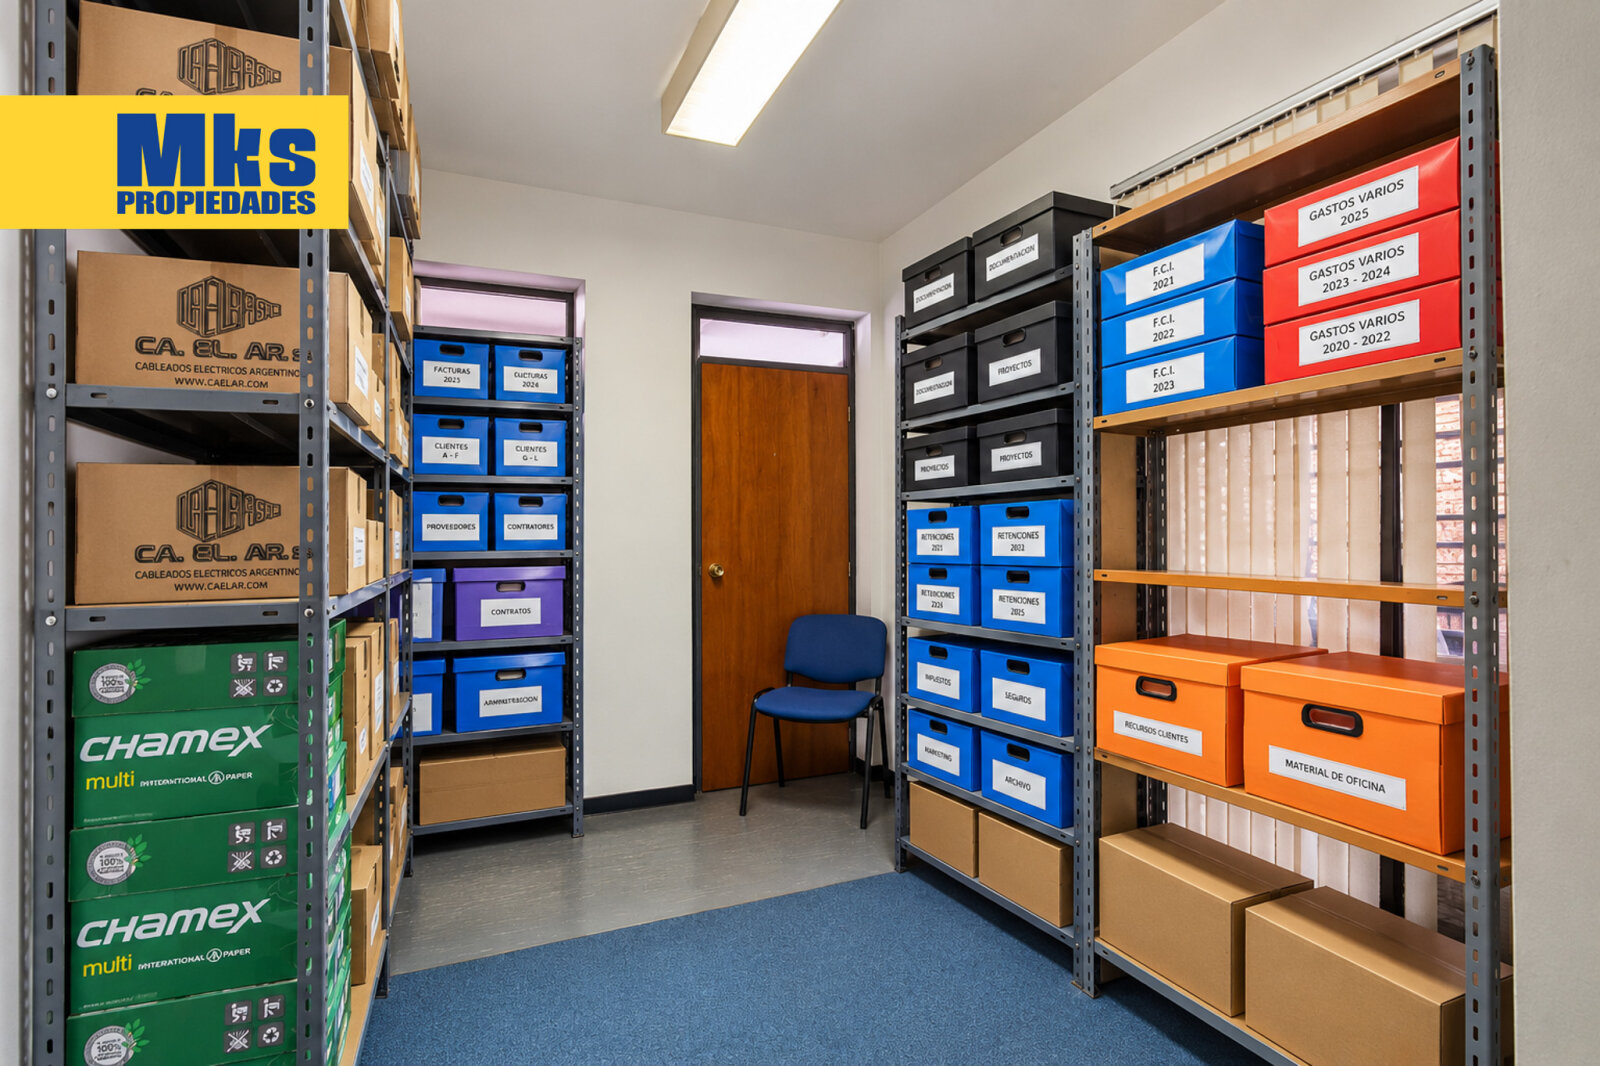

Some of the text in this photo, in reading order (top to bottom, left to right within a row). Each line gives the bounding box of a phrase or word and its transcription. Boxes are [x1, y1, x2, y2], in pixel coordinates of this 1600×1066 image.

[1309, 179, 1404, 221] GASTOS VARIOS
[1340, 207, 1369, 226] 2025
[1153, 263, 1174, 276] F.C.I.
[1309, 245, 1404, 281] GASTOS VARIOS
[1153, 276, 1174, 291] 2021
[1322, 277, 1350, 294] 2023
[1361, 266, 1391, 283] 2024
[1154, 314, 1175, 327] F.C.I.
[1309, 310, 1405, 342] GASTOS VARIOS
[1153, 328, 1175, 343] 2022
[1323, 340, 1350, 355] 2020
[1362, 331, 1391, 347] 2022
[135, 336, 184, 356] CA.
[193, 339, 237, 359] EL.
[244, 342, 289, 361] AR.
[135, 362, 191, 372] CABLEADOS
[194, 365, 247, 375] ELECTRICOS
[434, 366, 470, 374] FACTURAS
[1154, 366, 1174, 378] F.C.I.
[174, 377, 269, 390] WWW.CAELAR.COM
[1153, 381, 1175, 394] 2023
[135, 544, 184, 563] CA.
[192, 542, 237, 562] EL.
[244, 543, 289, 561] AR.
[135, 570, 191, 579] CABLEADOS
[194, 569, 247, 578] ELECTRICOS
[174, 582, 268, 591] WWW.CAELAR.COM
[1124, 720, 1189, 744] RECURSOS CLIENTES
[86, 771, 135, 791] multi
[225, 771, 253, 781] PAPER
[1005, 776, 1031, 791] ARCHIVO
[1285, 758, 1386, 794] MATERIAL DE OFICINA
[223, 947, 251, 959] PAPER
[83, 954, 132, 977] multi
